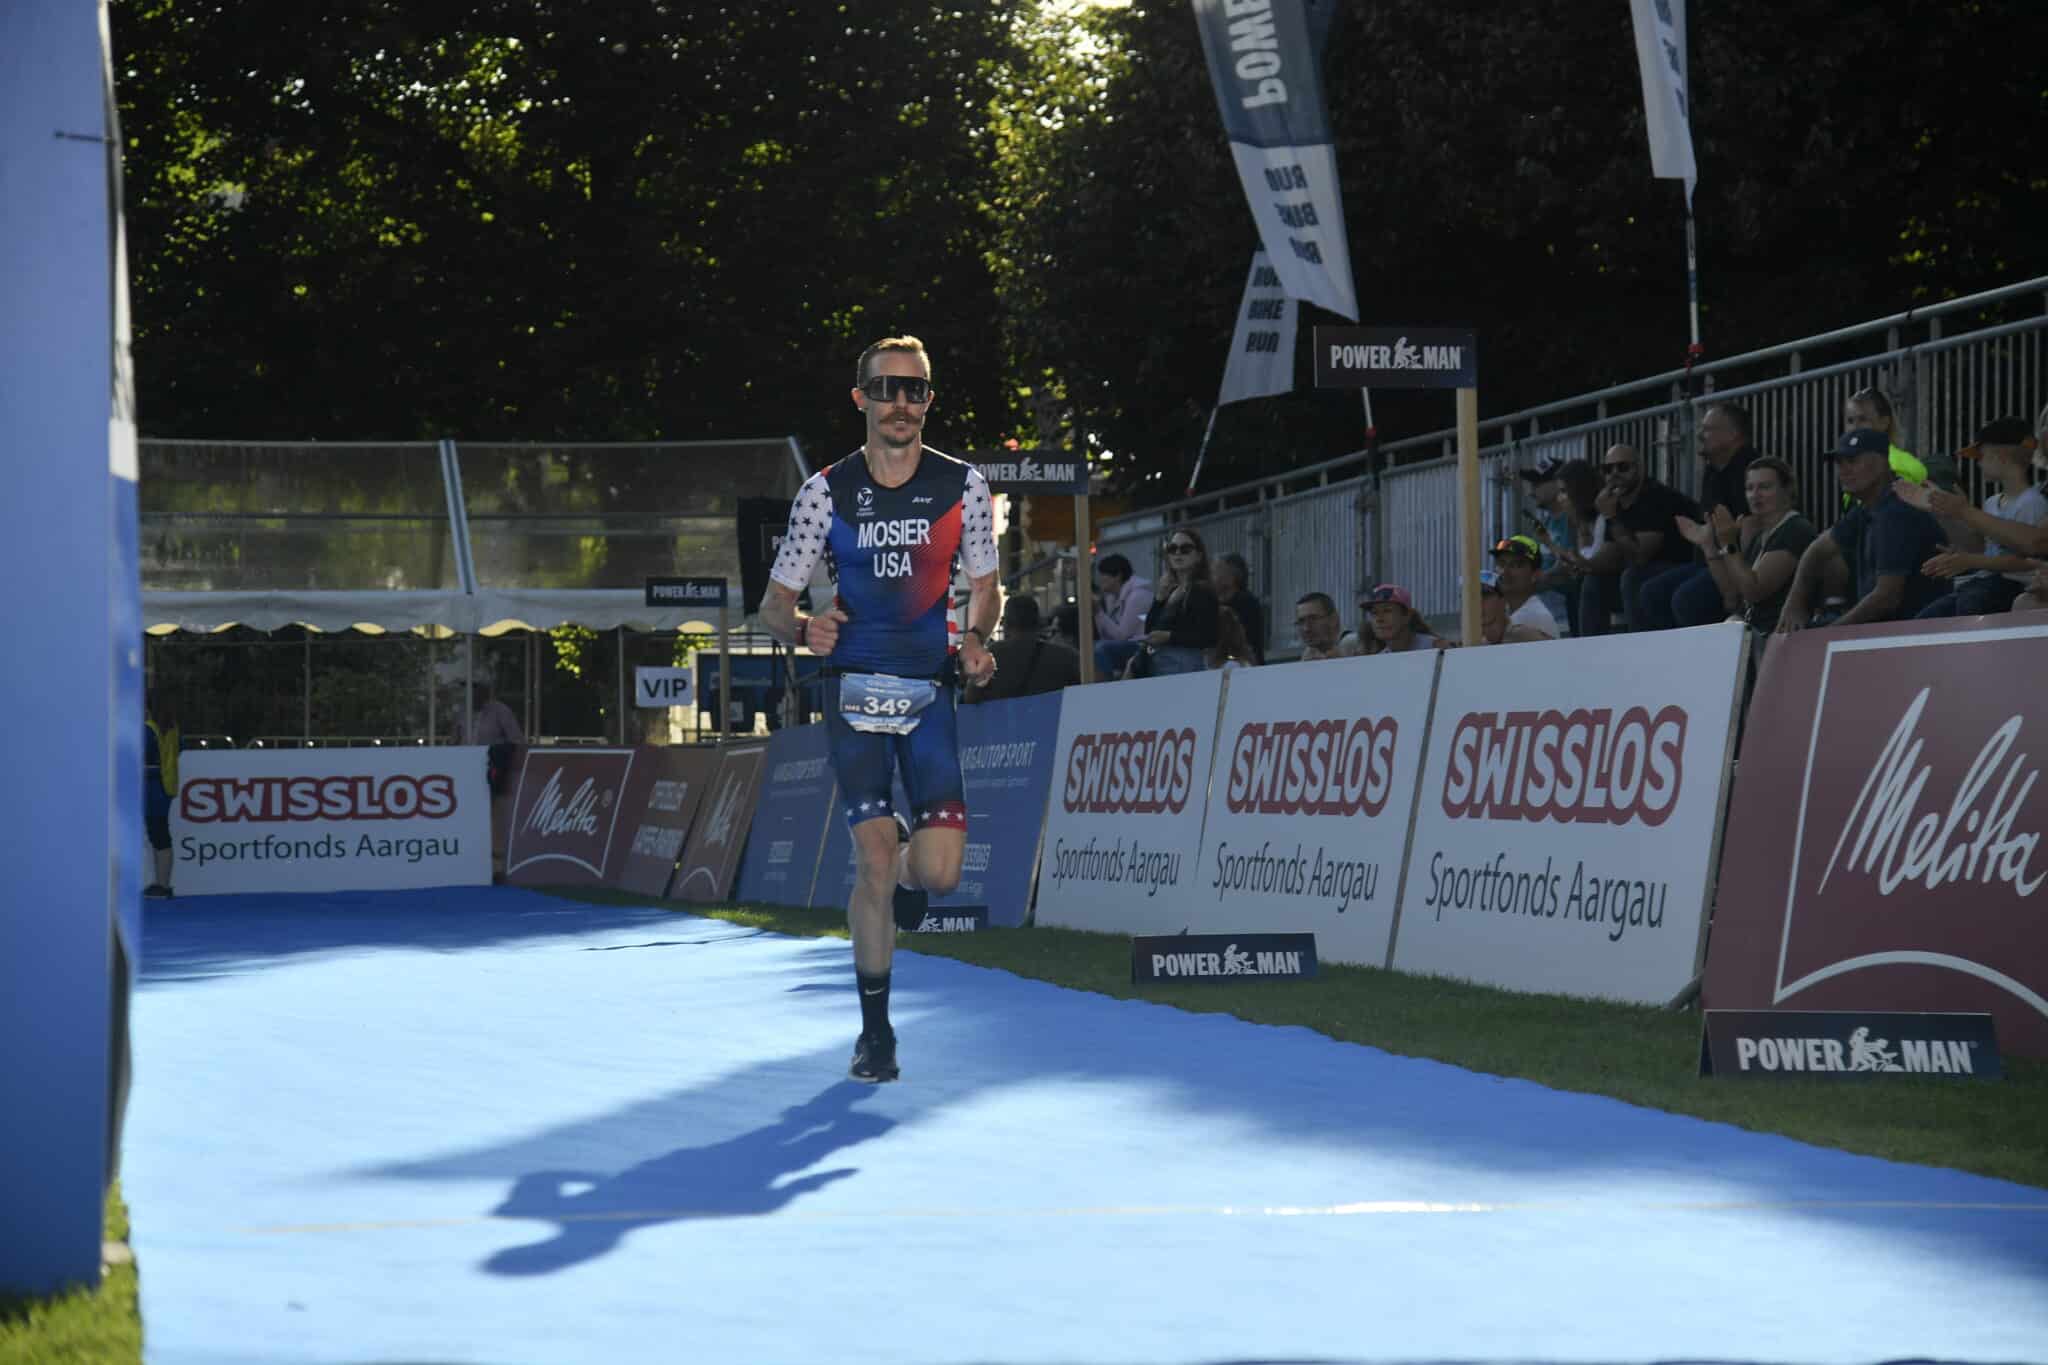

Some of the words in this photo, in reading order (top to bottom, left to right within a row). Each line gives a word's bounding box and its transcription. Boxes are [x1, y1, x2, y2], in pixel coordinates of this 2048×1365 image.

[1330, 345, 1391, 369] POWER
[1423, 345, 1462, 369] MAN
[975, 463, 1019, 481] OWER
[1043, 463, 1075, 481] MAN
[857, 518, 931, 548] MOSIER
[873, 551, 913, 578] USA
[643, 678, 687, 698] VIP
[863, 696, 912, 715] 349
[1064, 728, 1196, 815] SWISSLOS
[1227, 717, 1398, 817] SWISSLOS
[1441, 705, 1688, 827] SWISSLOS
[181, 776, 456, 822] SWISSLOS
[520, 766, 600, 838] Melitta
[1818, 687, 2048, 897] Melitta
[180, 834, 346, 866] Sportfonds
[356, 834, 459, 863] Aargau
[1052, 837, 1123, 890] Sportfonds
[1125, 840, 1183, 897] Aargau
[1212, 841, 1307, 902] Sportfonds
[1307, 847, 1379, 913] Aargau
[1425, 851, 1561, 922] Sportfonds
[1563, 860, 1667, 942] Aargau
[943, 917, 976, 932] MAN
[1152, 954, 1220, 977] POWER
[1257, 951, 1301, 974] MAN
[1736, 1038, 1844, 1071] POWER
[1900, 1040, 1973, 1073] MAN
